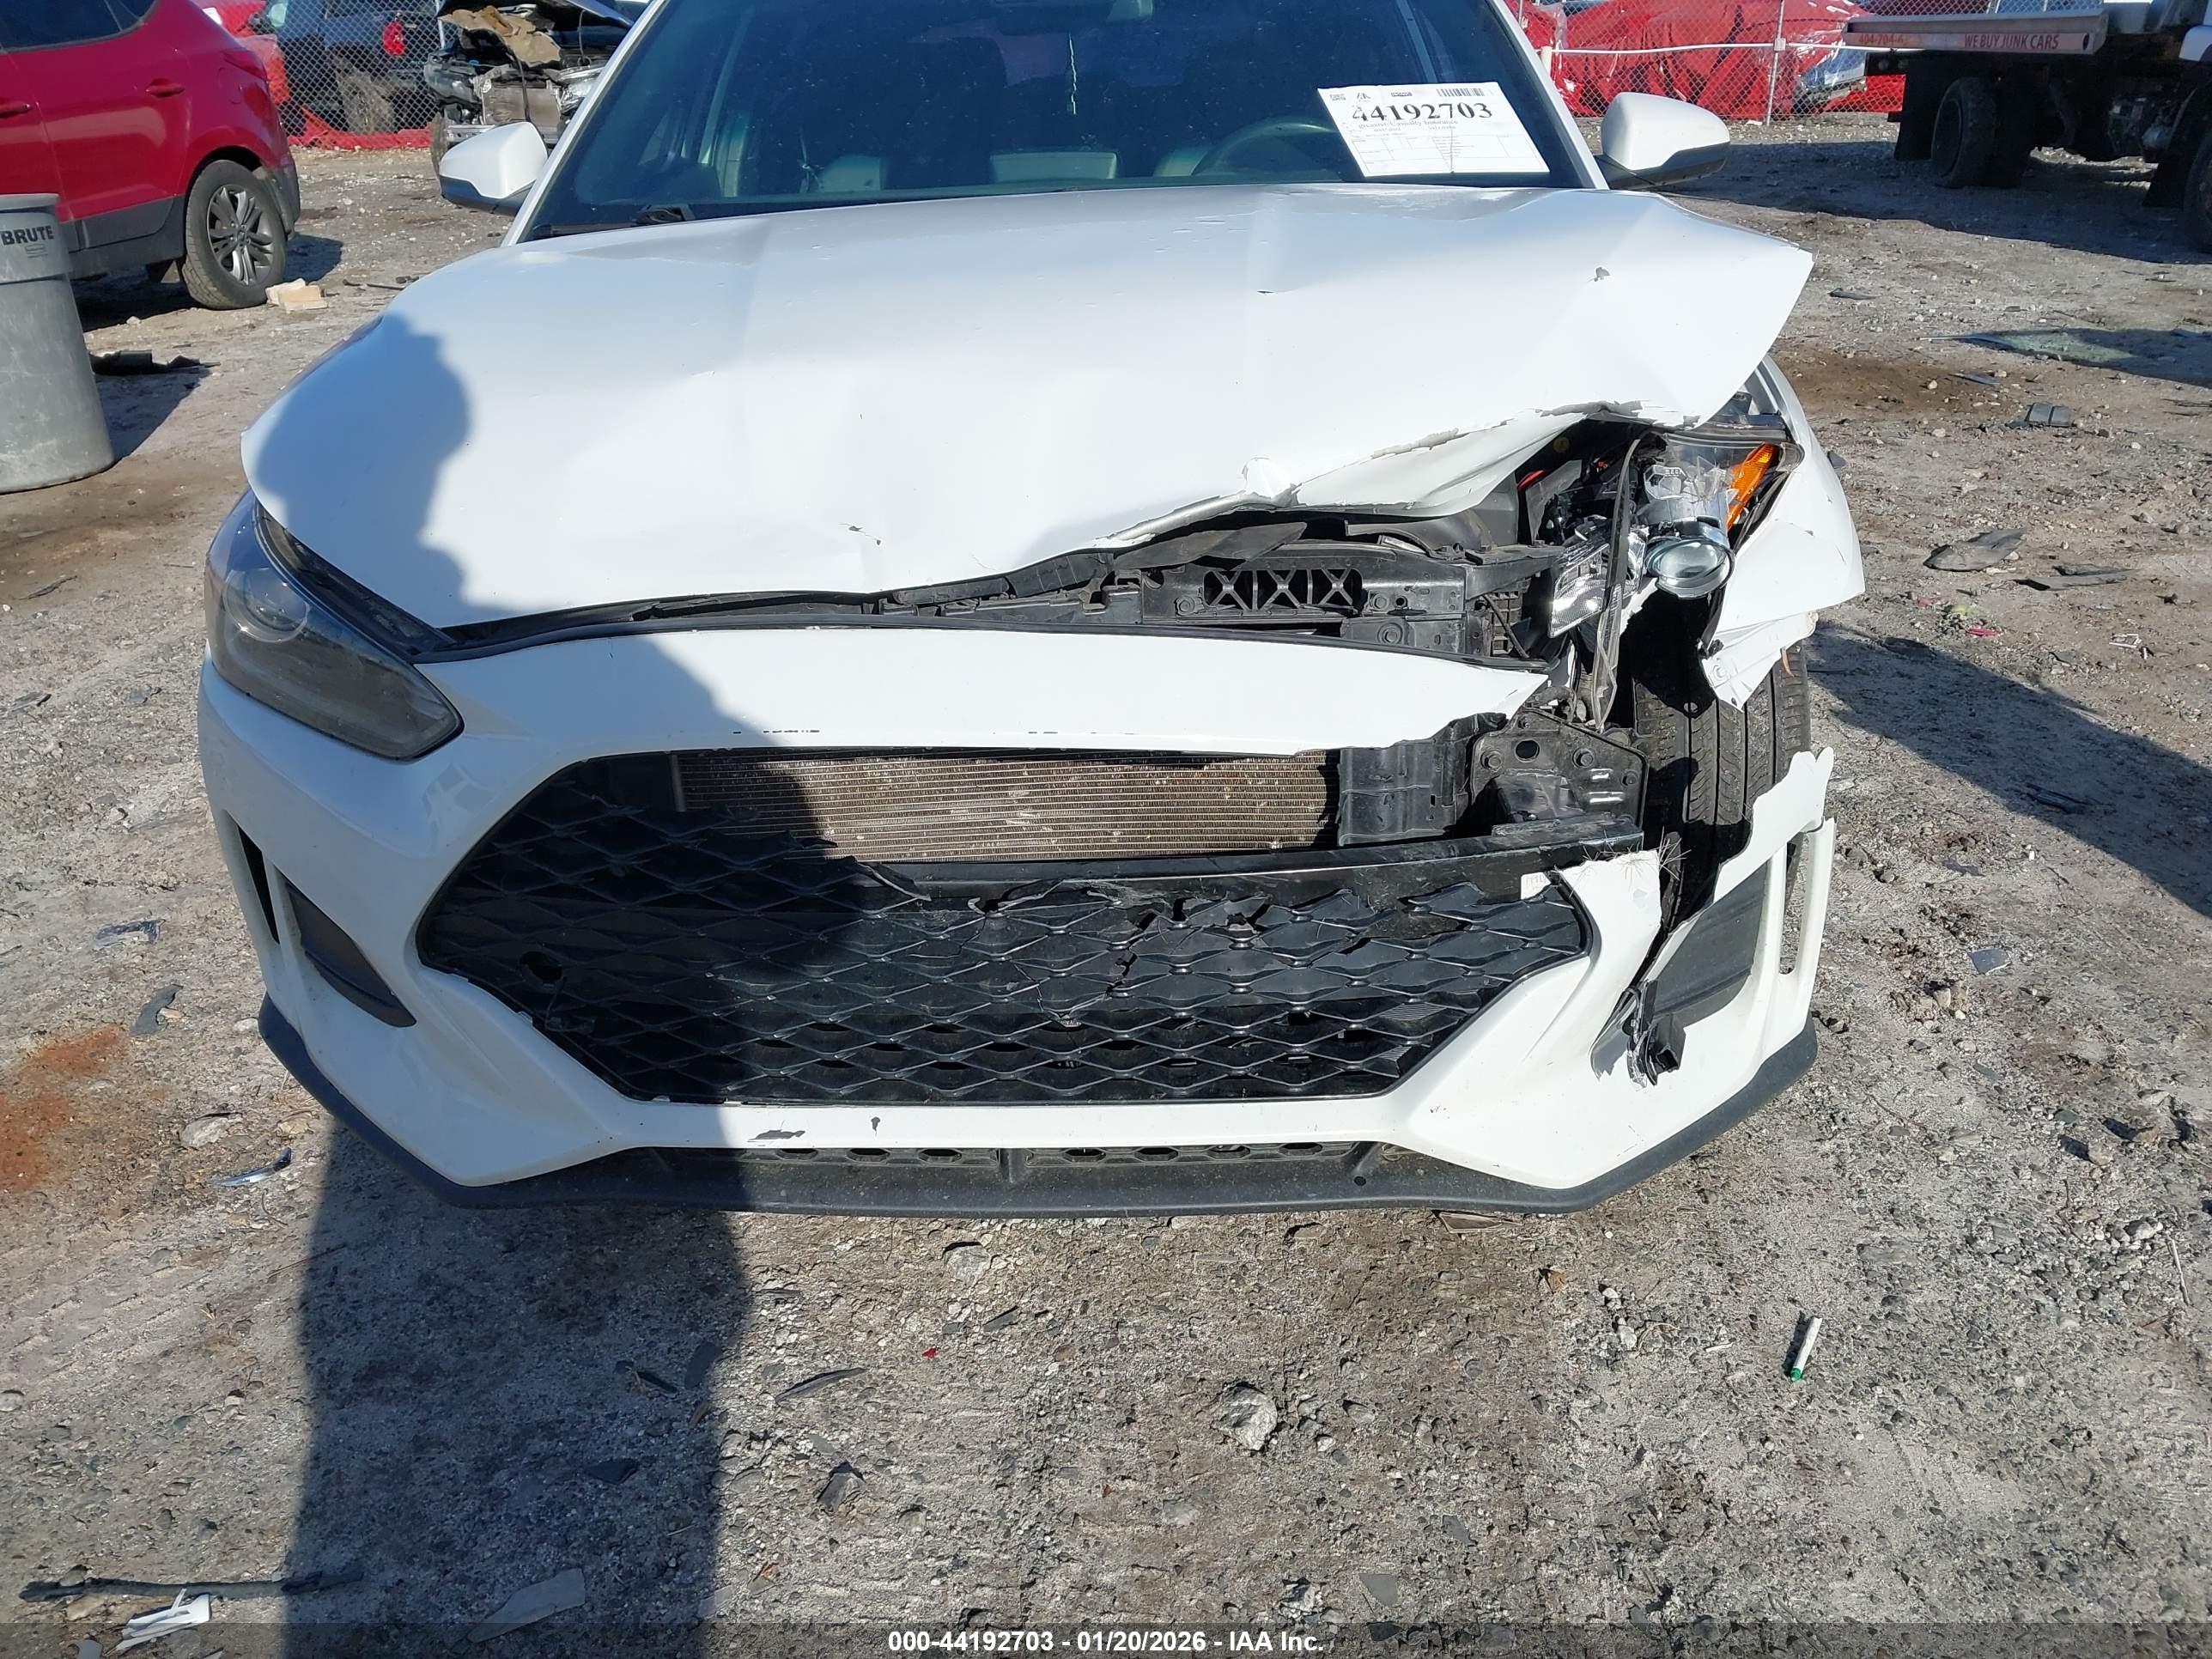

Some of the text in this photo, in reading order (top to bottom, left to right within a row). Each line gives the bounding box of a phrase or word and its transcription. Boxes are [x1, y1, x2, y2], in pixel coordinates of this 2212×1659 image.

[1965, 33, 2061, 50] WE BUY JUNK CARS
[1352, 102, 1493, 122] 44192703
[0, 225, 55, 246] BRUTE
